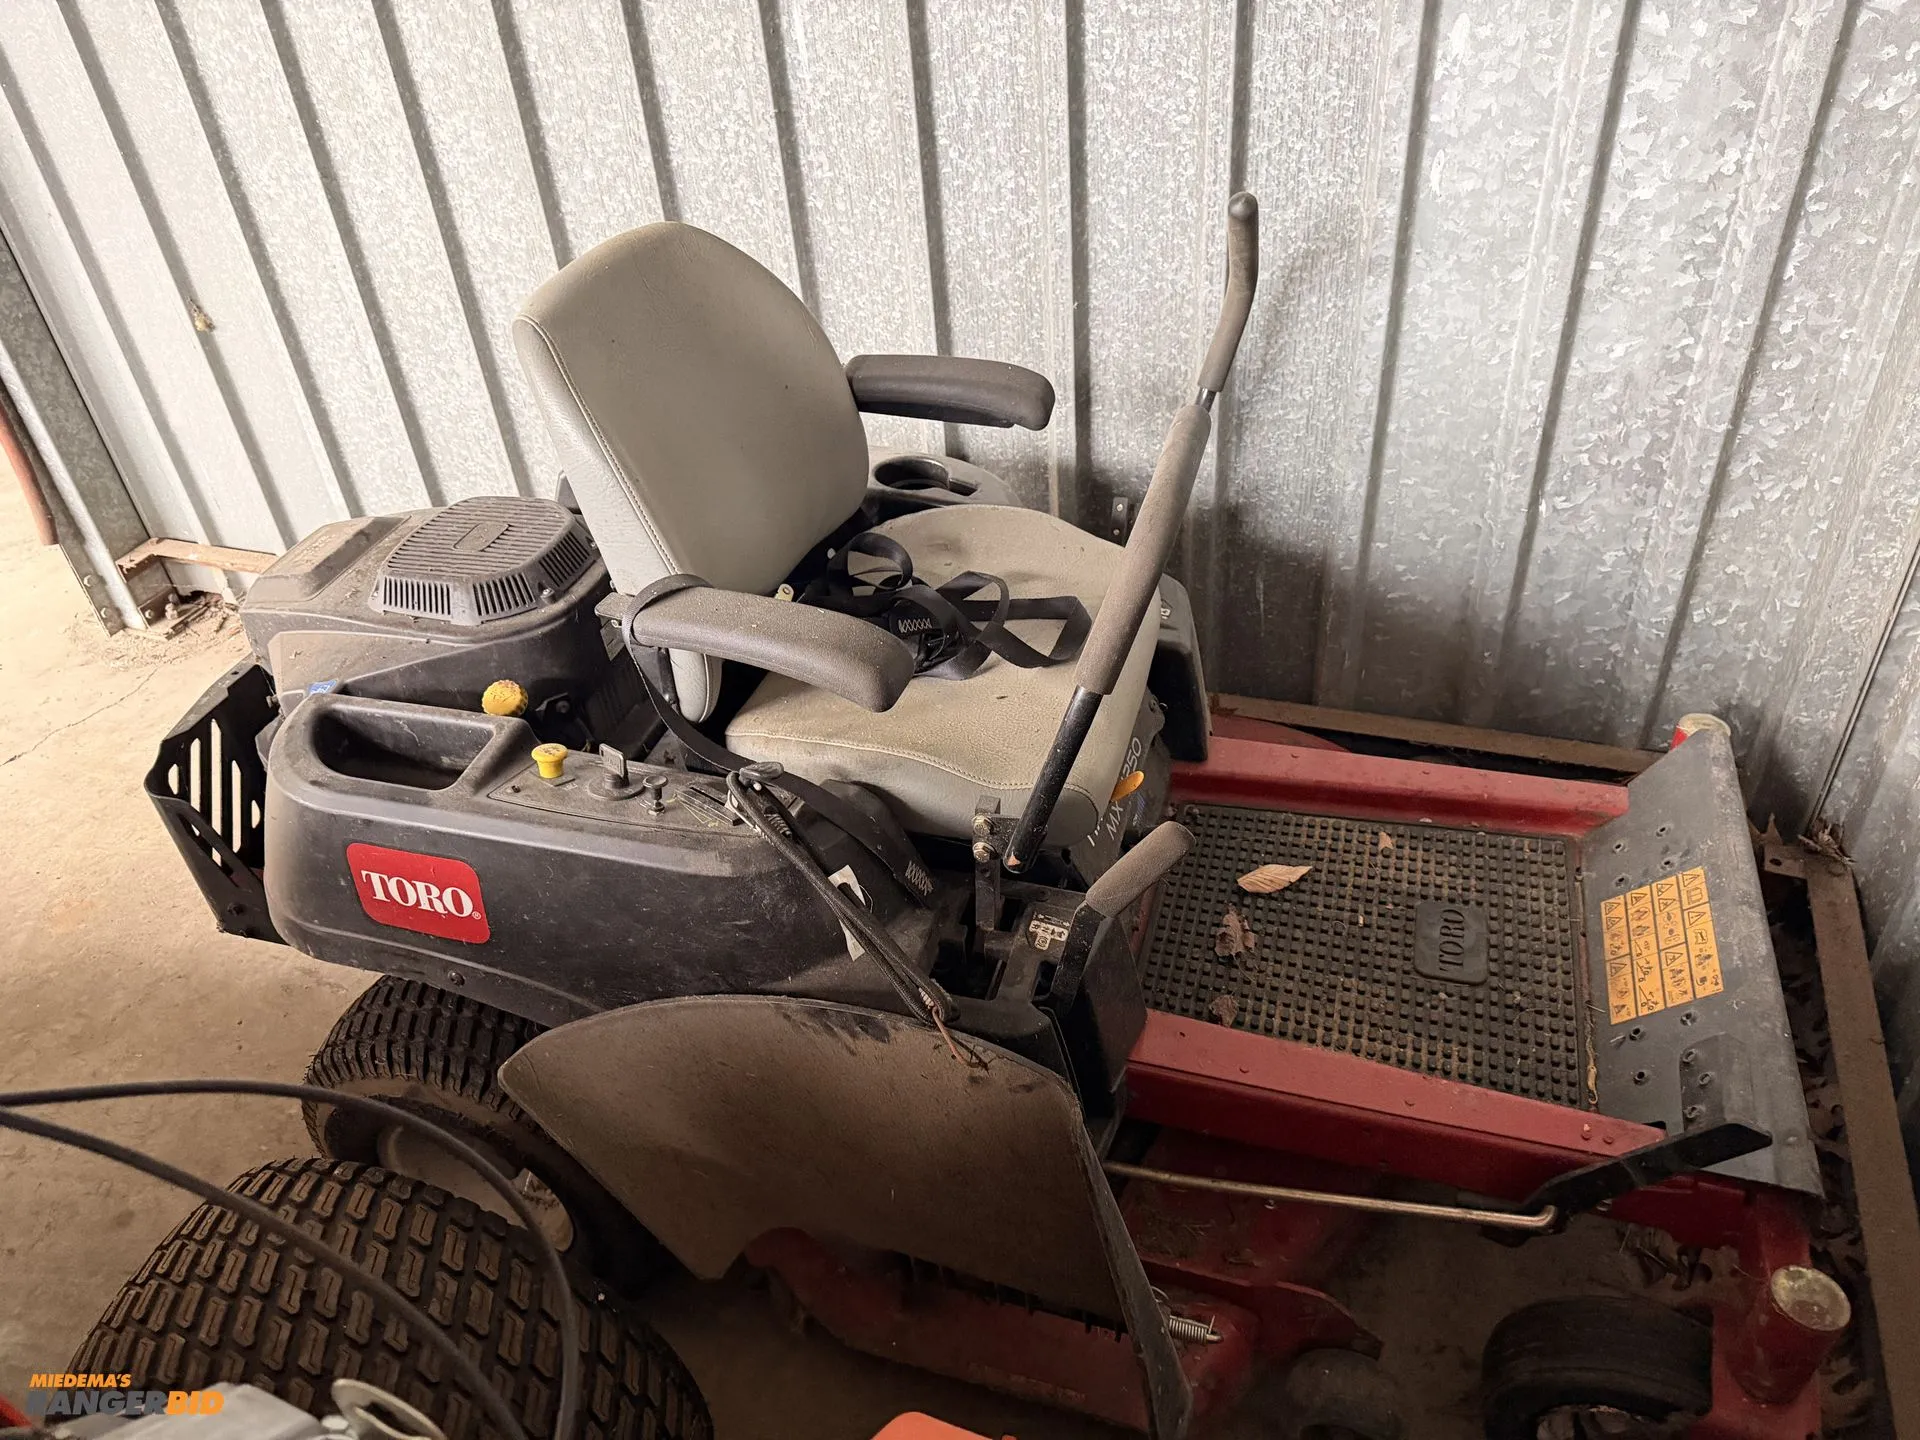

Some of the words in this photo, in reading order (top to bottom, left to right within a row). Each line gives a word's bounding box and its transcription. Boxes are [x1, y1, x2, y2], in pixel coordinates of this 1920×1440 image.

[1106, 801, 1124, 840] MX
[1120, 737, 1142, 780] 250
[1439, 909, 1464, 972] TORO
